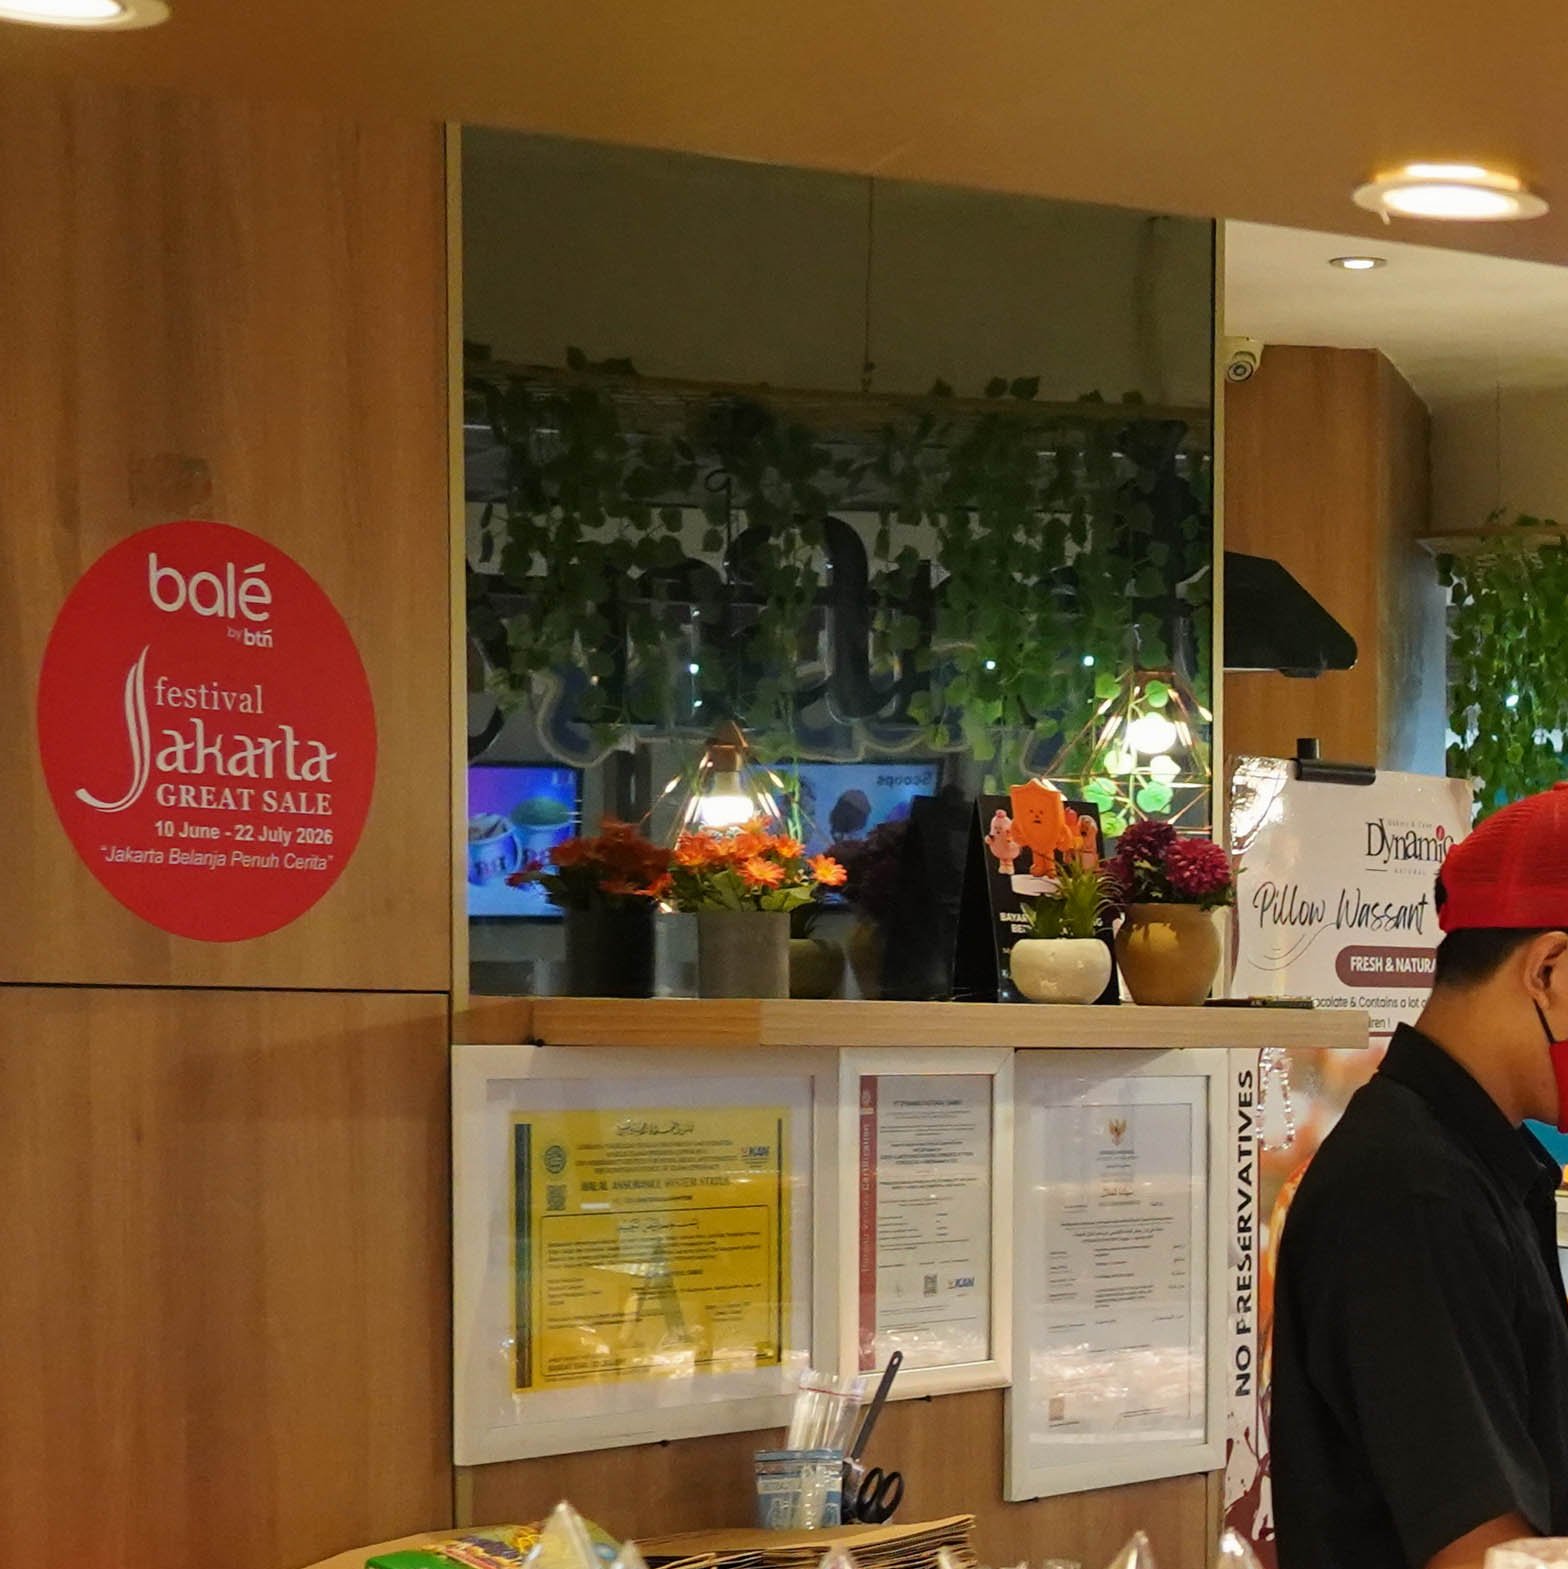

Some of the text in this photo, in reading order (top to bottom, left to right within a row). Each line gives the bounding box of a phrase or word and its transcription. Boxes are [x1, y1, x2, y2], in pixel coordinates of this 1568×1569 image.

[148, 552, 272, 622] balé
[155, 677, 263, 715] festival
[75, 644, 337, 813] Jakarta
[155, 784, 333, 816] GREAT SALE
[155, 821, 173, 838] 10
[178, 822, 220, 840] June
[235, 825, 254, 841] 22
[258, 825, 292, 847] July
[296, 827, 333, 845] 2026
[168, 848, 227, 869] Belanja
[230, 850, 279, 869] Penuh
[1253, 881, 1428, 935] Pillow Wassant
[1350, 956, 1384, 972] FRESH
[1385, 957, 1395, 971] &
[1358, 996, 1398, 1009] Contains
[1235, 1069, 1254, 1397] NO PRESERVATIVES
